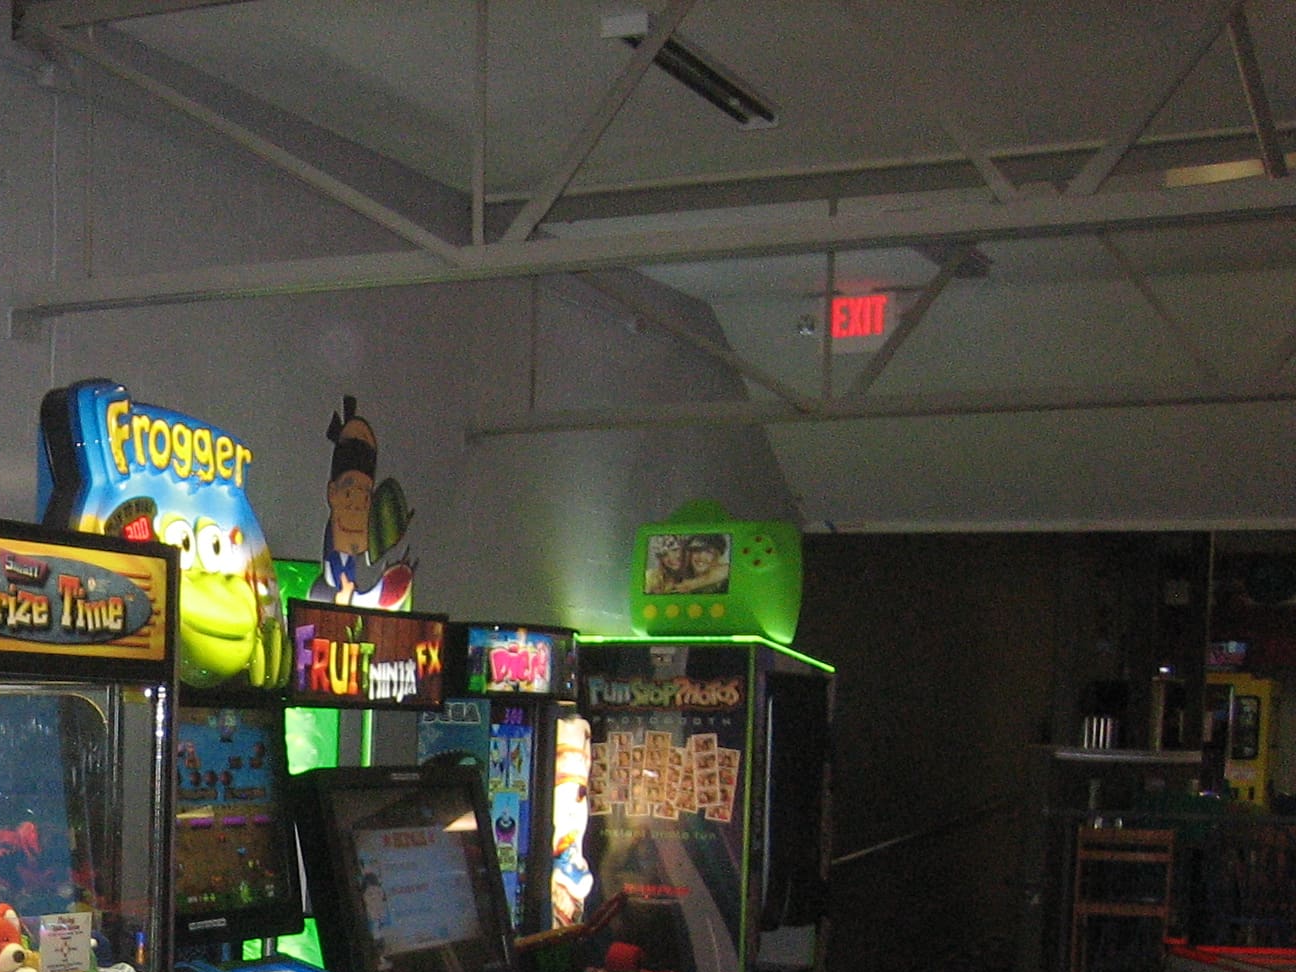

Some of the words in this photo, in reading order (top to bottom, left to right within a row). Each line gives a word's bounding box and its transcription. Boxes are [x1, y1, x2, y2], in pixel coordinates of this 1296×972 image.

[831, 294, 888, 338] EXIT
[106, 400, 254, 488] Frogger
[296, 624, 375, 696] FRUIT
[415, 639, 443, 680] FX
